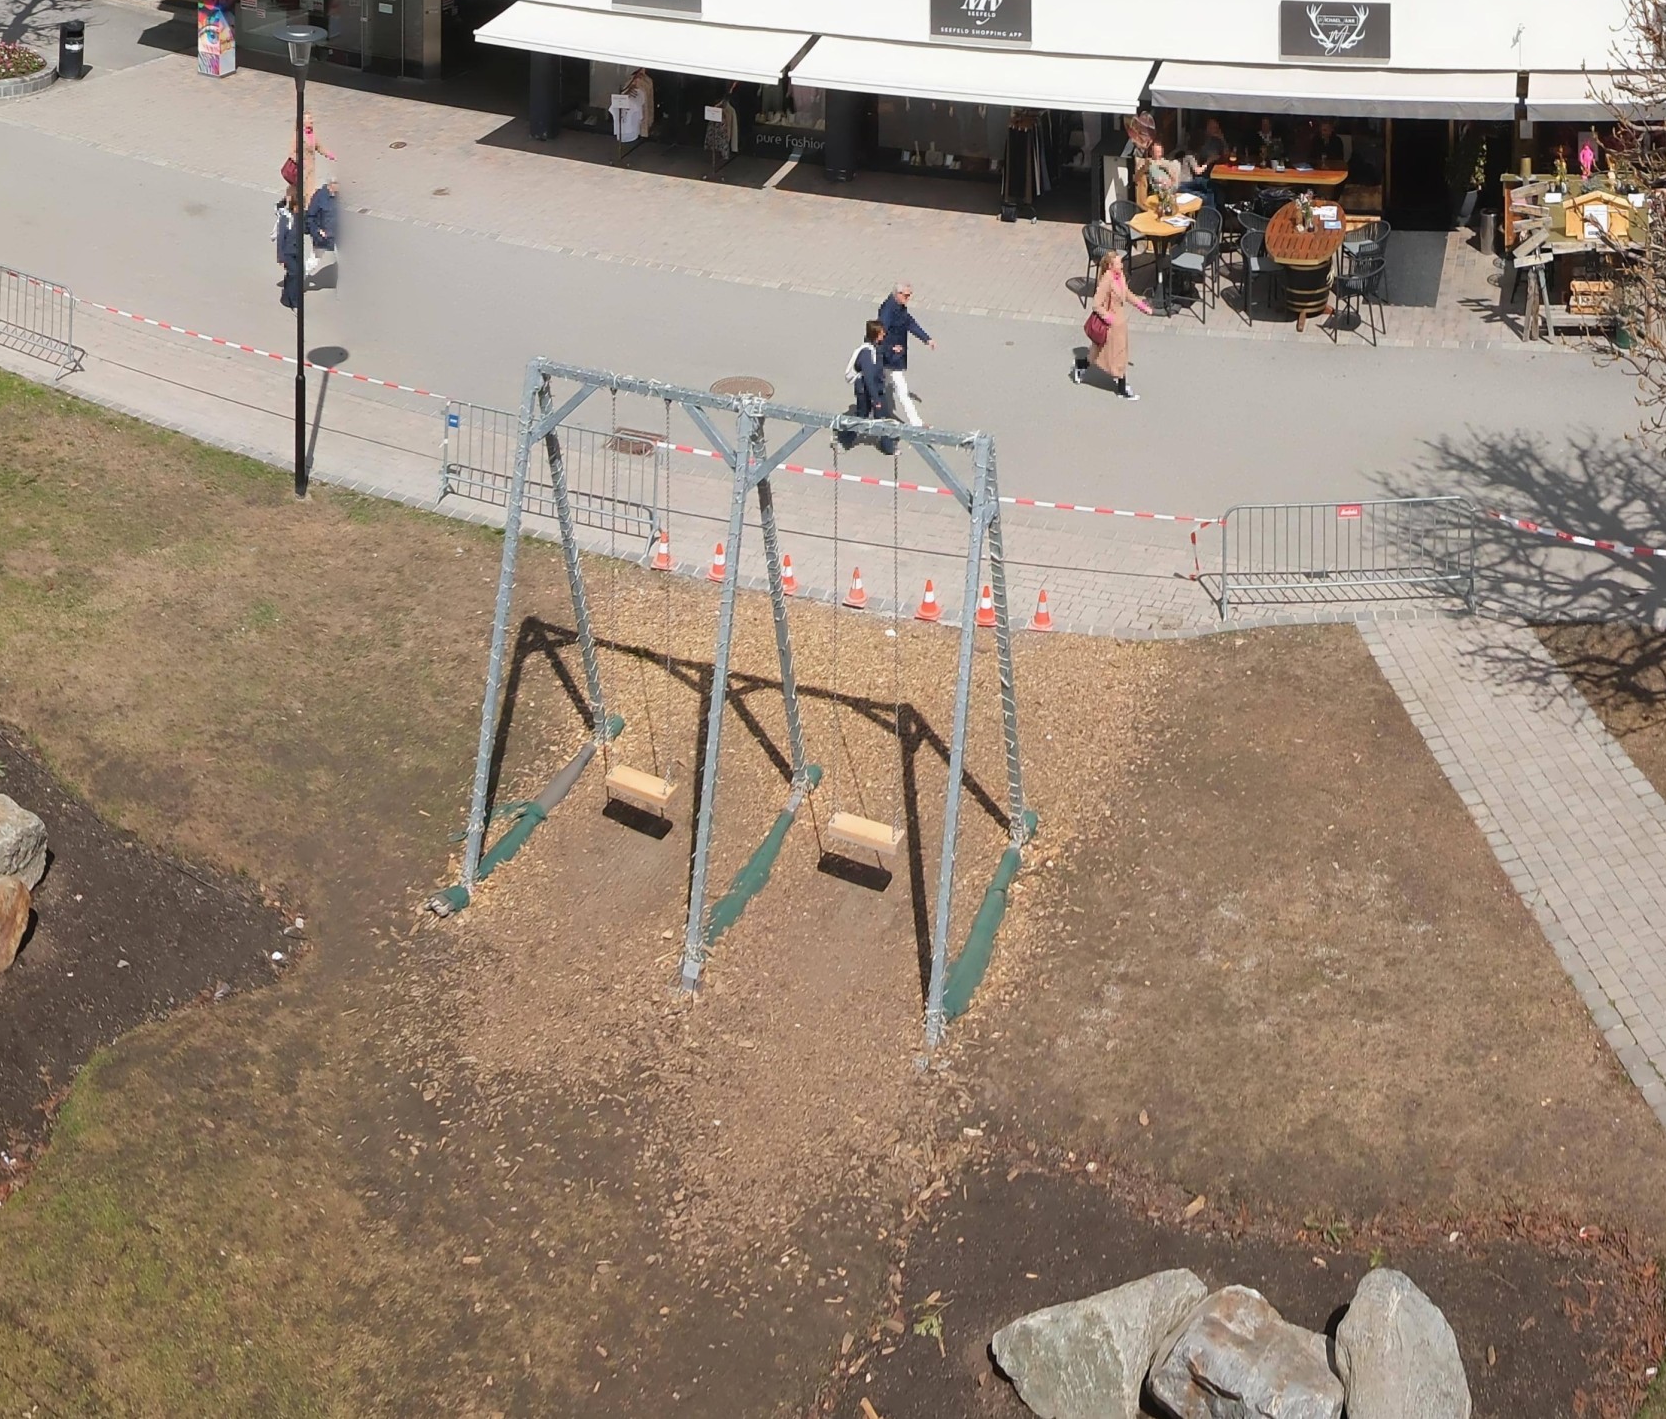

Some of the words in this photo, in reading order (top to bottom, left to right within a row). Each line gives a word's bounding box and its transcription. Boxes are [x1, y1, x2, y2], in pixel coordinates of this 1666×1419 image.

[967, 10, 997, 18] SEEFELD
[940, 27, 970, 35] SEEFELD
[971, 29, 1007, 38] SHOPPING
[756, 133, 782, 144] pure
